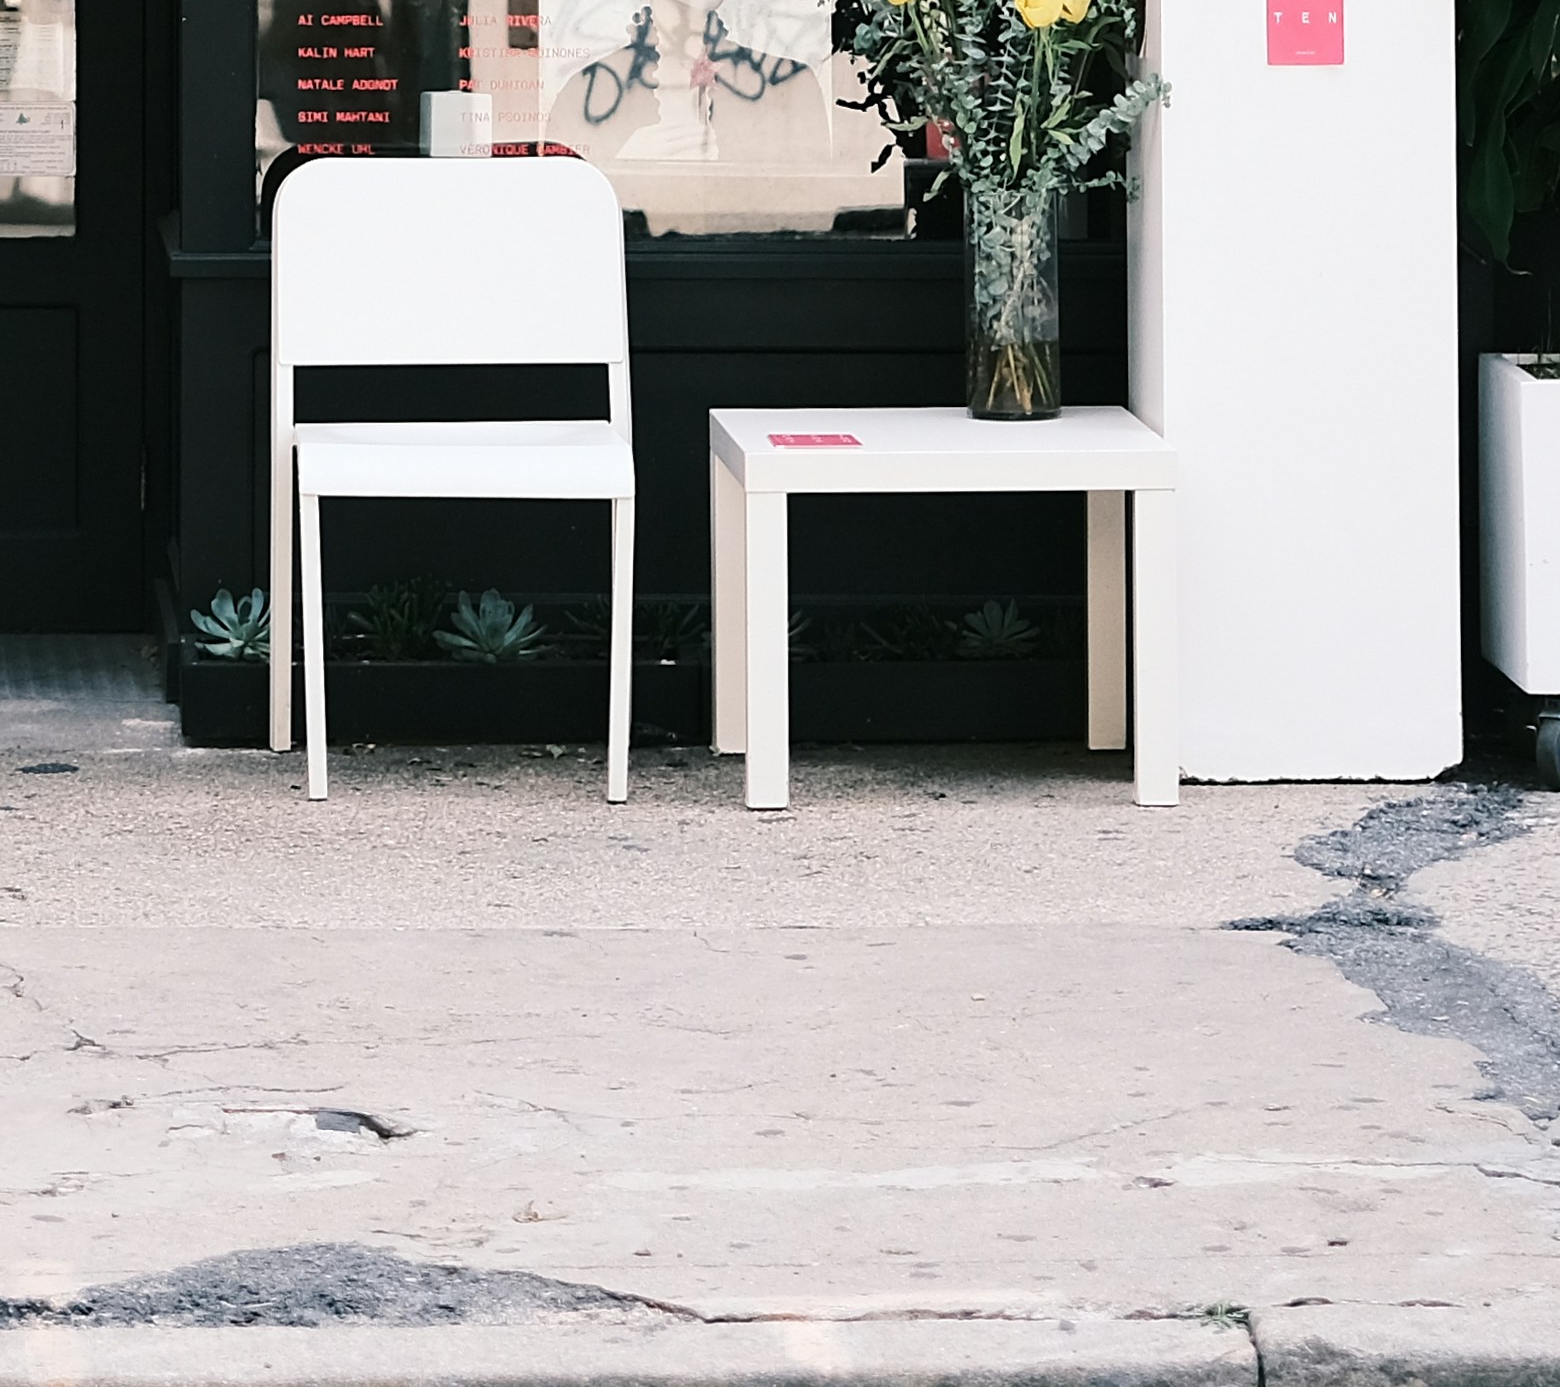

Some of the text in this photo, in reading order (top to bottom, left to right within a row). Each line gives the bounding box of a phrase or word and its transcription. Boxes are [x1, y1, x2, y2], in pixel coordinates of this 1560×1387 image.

[320, 14, 384, 27] CAMPBELL
[458, 14, 553, 27] JULIA RIVERA
[297, 47, 376, 59] KALIN HART
[297, 79, 345, 91] NATALE
[458, 79, 484, 91] PAT
